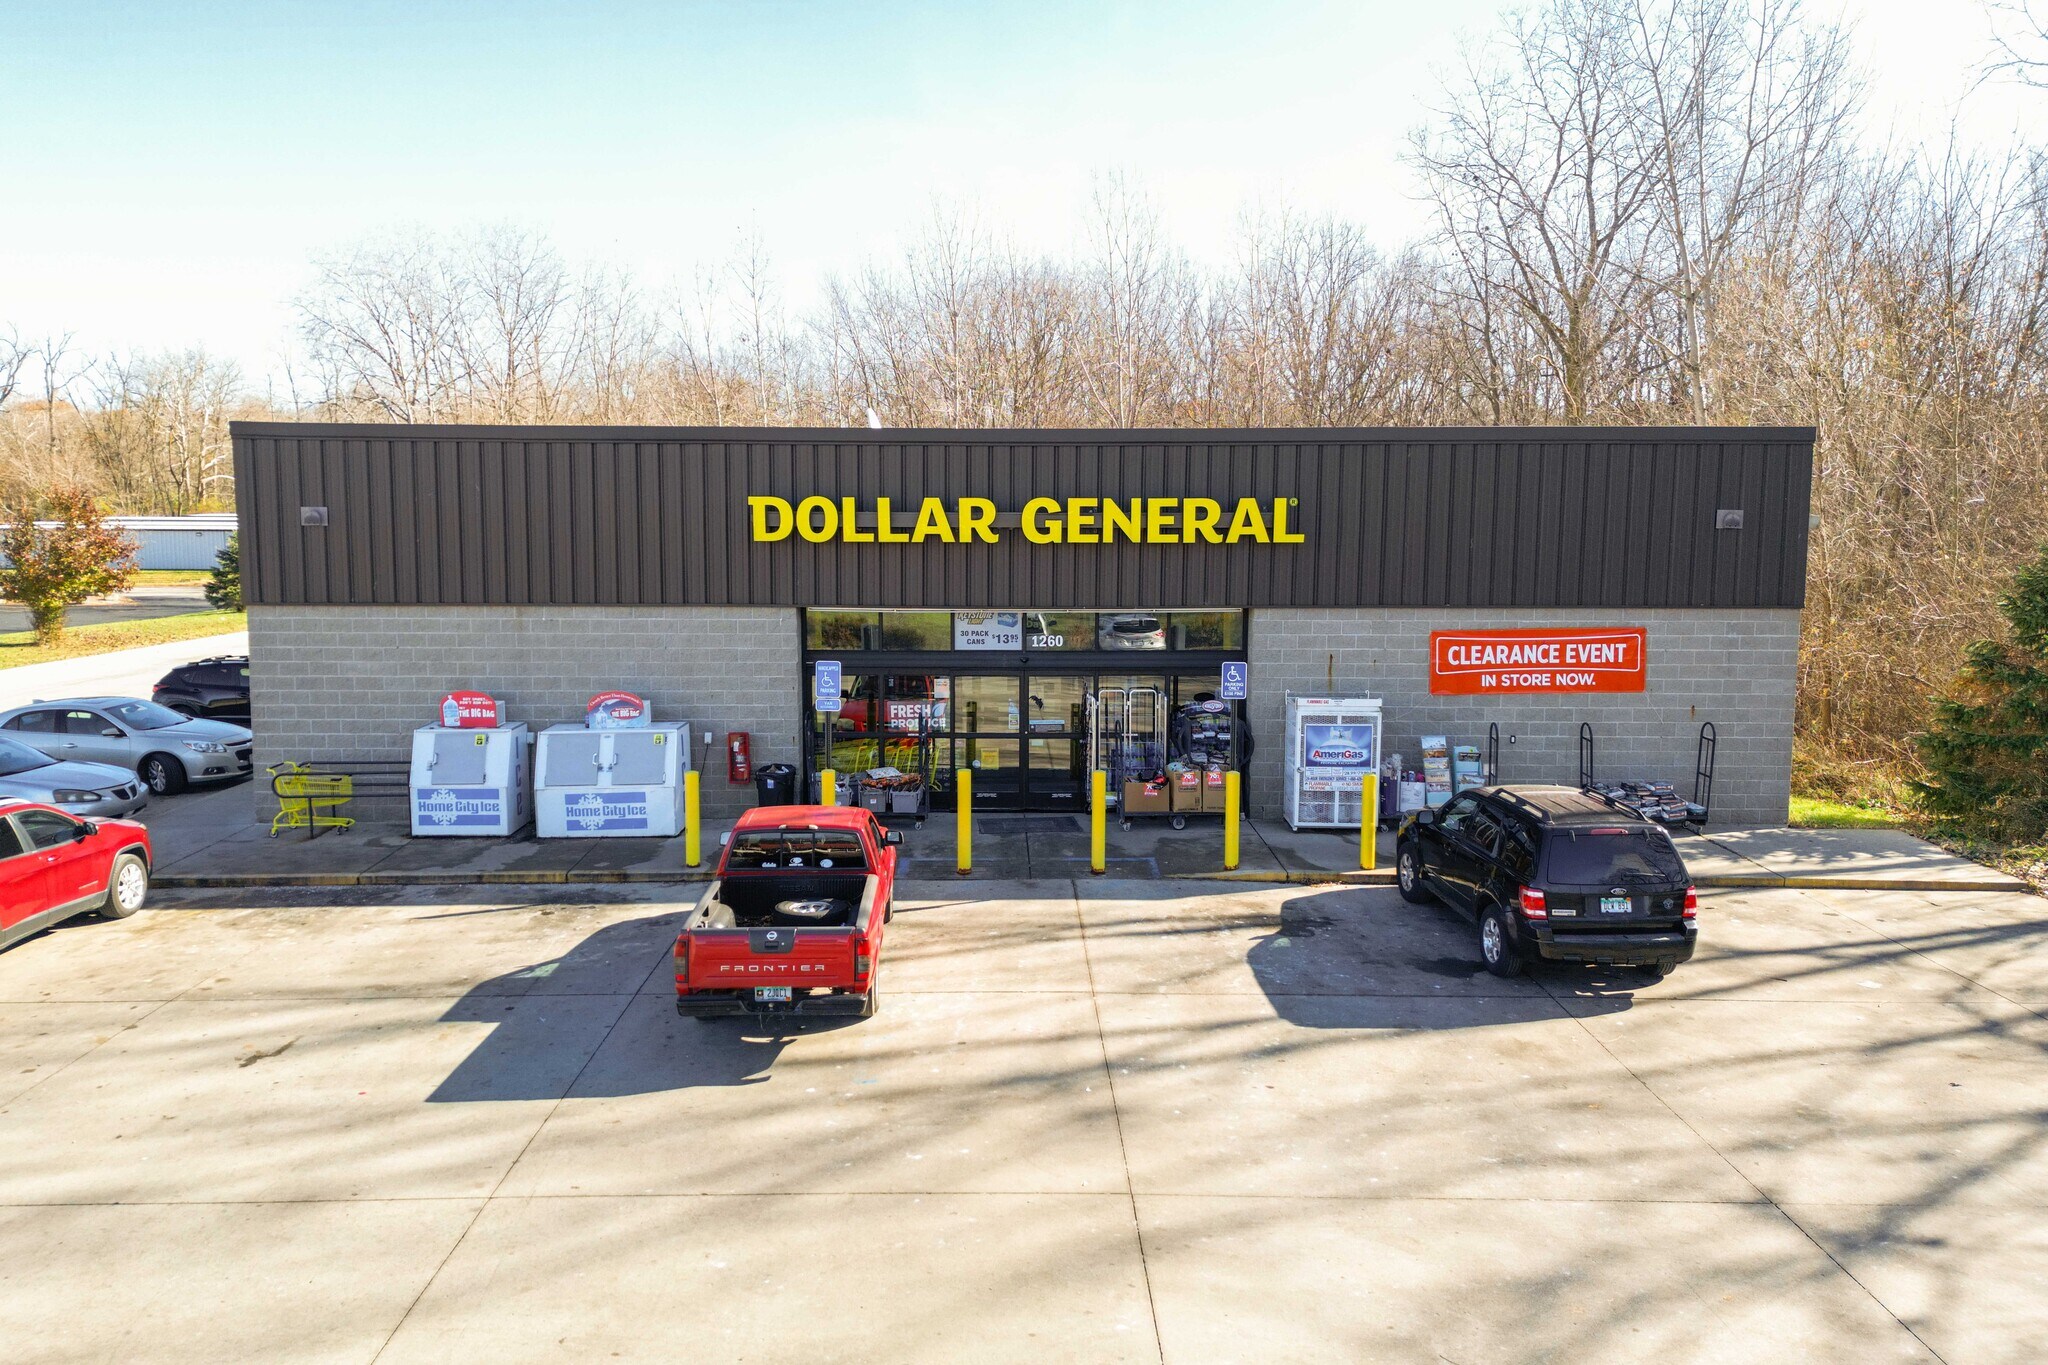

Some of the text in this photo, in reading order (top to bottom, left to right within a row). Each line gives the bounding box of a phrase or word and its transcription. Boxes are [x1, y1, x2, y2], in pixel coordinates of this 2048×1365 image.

[748, 496, 1305, 544] DOLLAR GENERAL
[1031, 635, 1064, 647] 1260
[1448, 643, 1627, 666] CLEARANCE EVENT
[1481, 672, 1596, 687] IN STORE NOW.
[459, 708, 495, 718] THE BIG BAG
[890, 704, 931, 718] FRESH
[1312, 750, 1364, 759] AmeriGas
[418, 801, 500, 814] Home City Ice
[566, 805, 647, 818] Home City Ice
